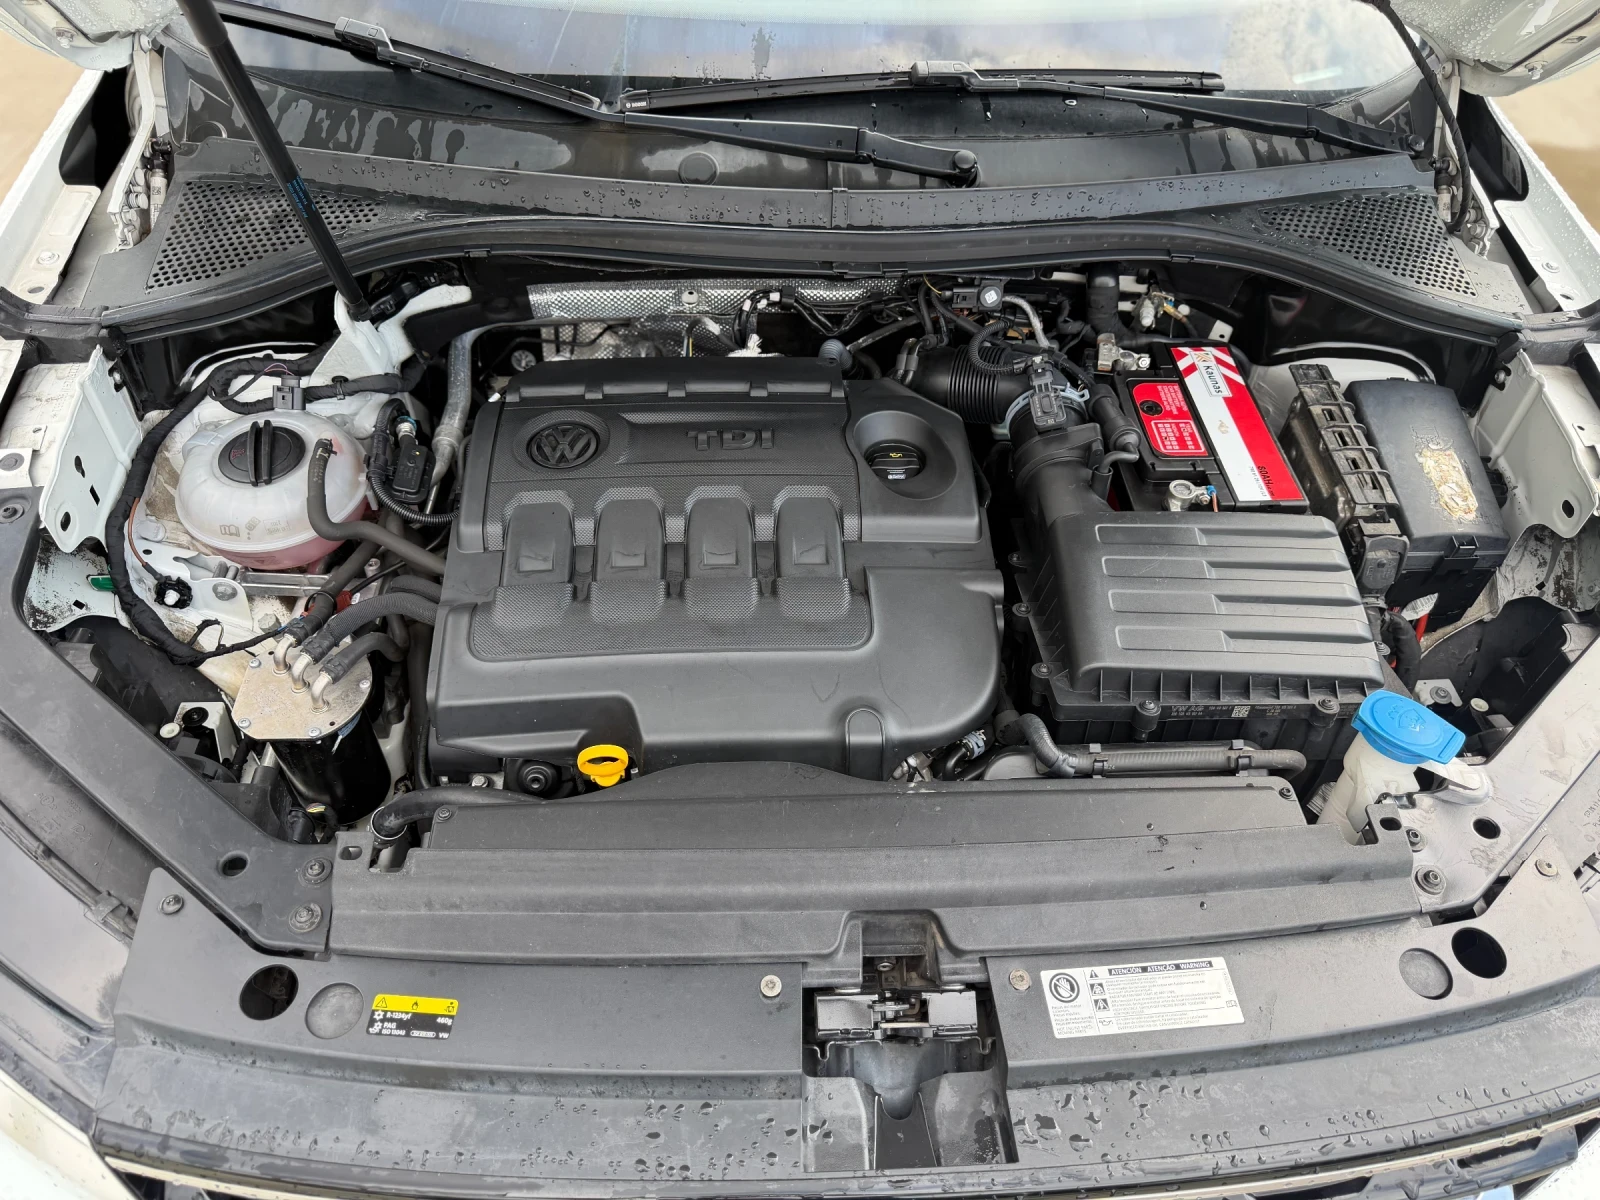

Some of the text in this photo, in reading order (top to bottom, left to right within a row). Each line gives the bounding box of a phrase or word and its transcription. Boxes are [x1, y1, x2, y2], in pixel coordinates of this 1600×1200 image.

[1203, 365, 1223, 394] Kaunas
[687, 430, 774, 451] TDI
[1111, 961, 1210, 975] ATENCIÓN ATENÇÃO WARNING
[386, 1011, 453, 1026] R-1234yf 460g
